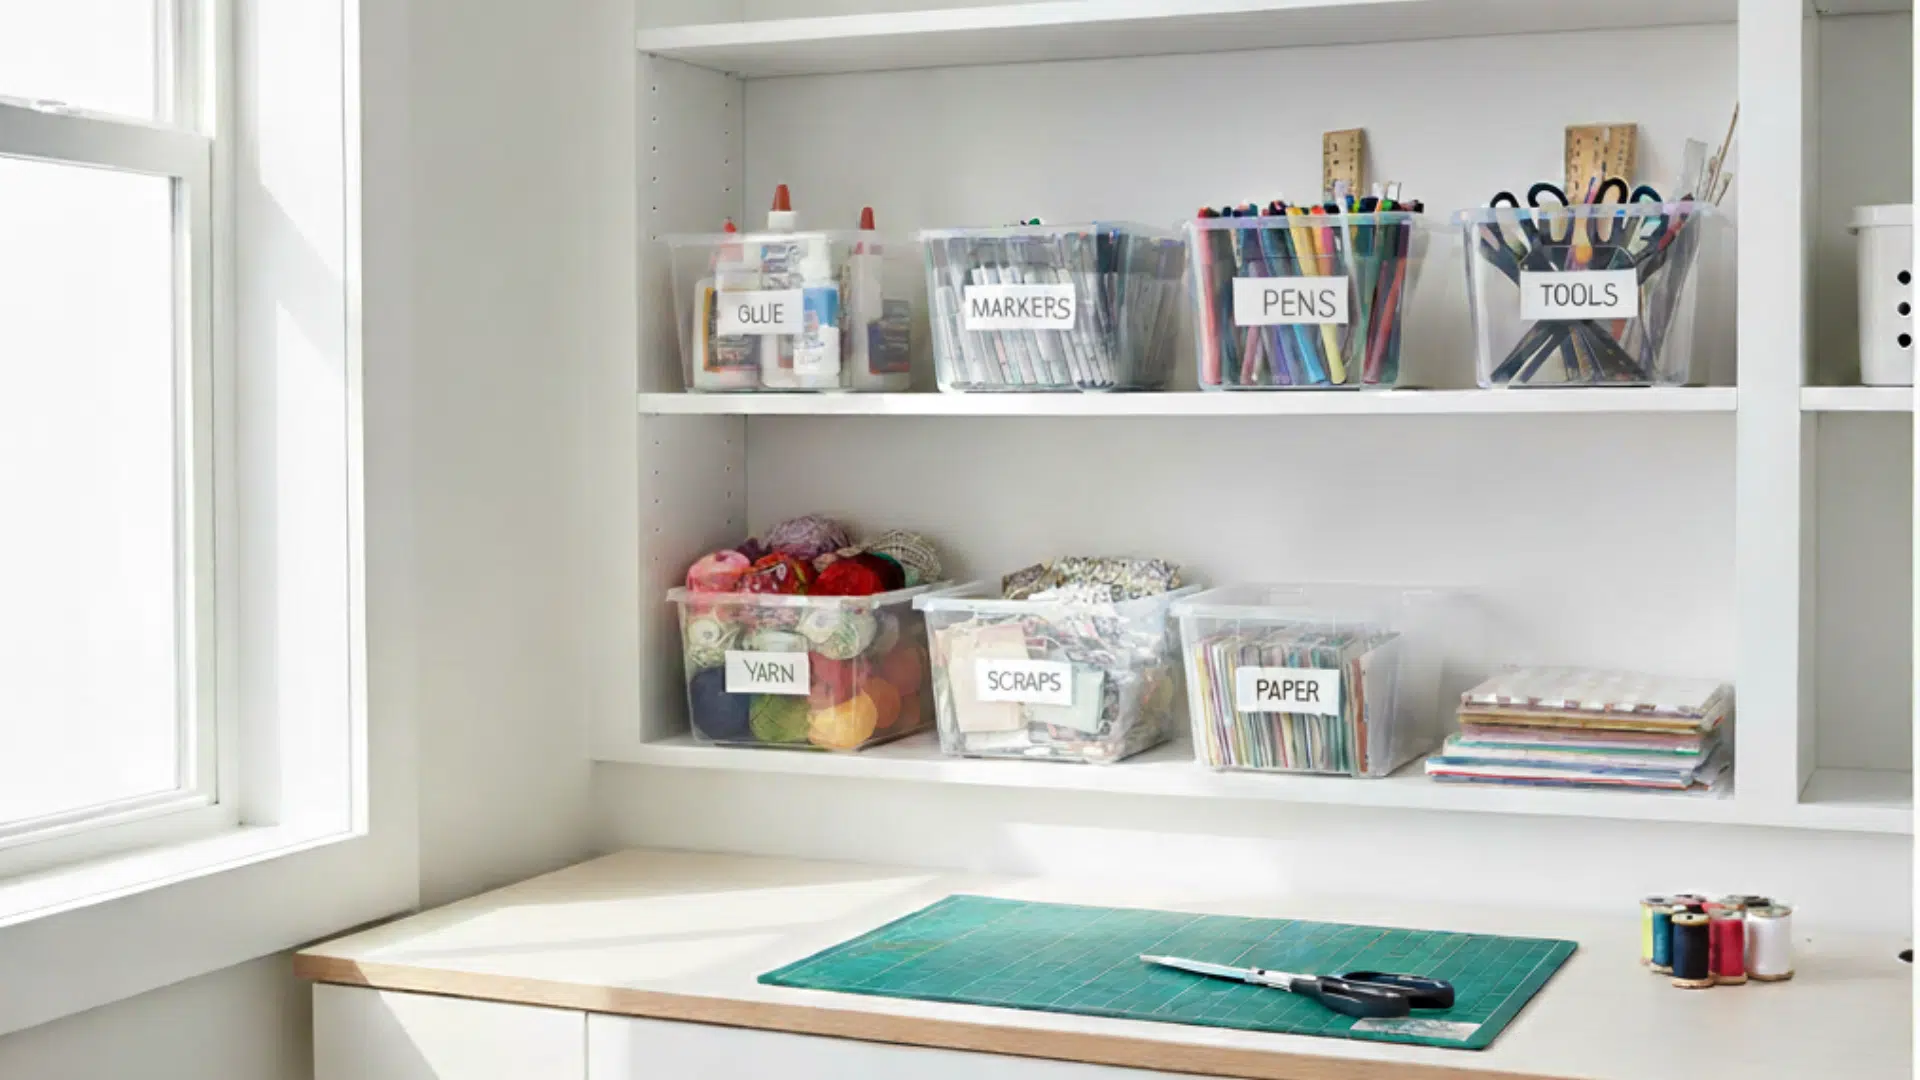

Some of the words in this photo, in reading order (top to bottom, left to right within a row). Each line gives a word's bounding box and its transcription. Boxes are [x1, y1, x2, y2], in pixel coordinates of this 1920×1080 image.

[1264, 288, 1336, 318] PENS
[1540, 283, 1618, 307] TOOLS
[738, 303, 784, 324] GLUE
[972, 296, 1071, 320] MARKERS
[743, 659, 795, 683] YARN
[988, 671, 1061, 692] SCRAPS
[1256, 679, 1320, 702] PAPER
